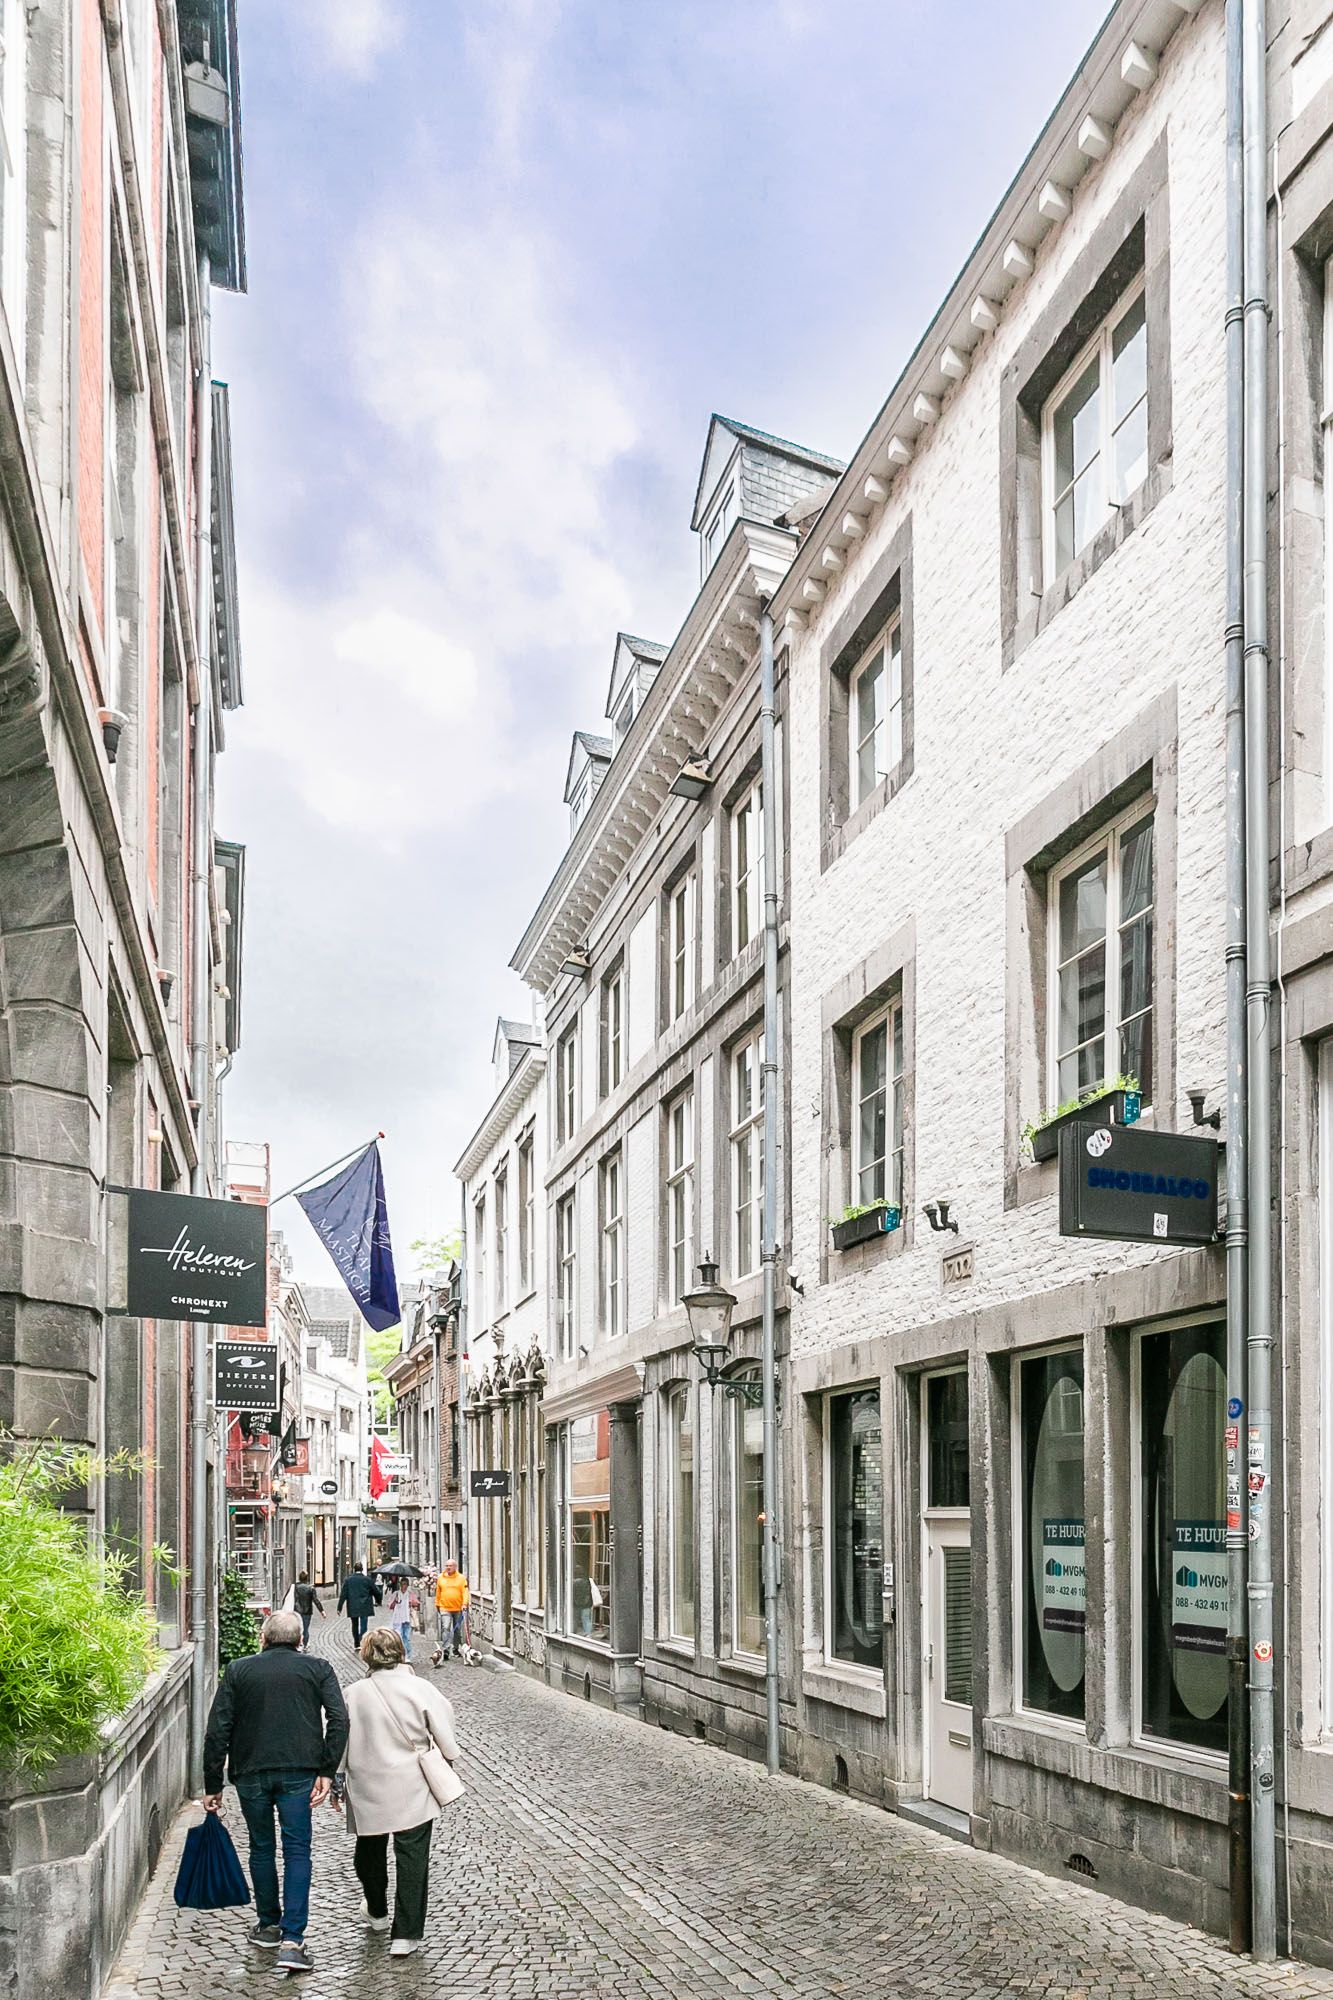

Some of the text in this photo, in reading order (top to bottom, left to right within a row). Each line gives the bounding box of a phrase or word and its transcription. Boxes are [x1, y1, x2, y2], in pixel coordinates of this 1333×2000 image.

[1088, 1167, 1209, 1199] SHOEBALOO
[140, 1225, 257, 1271] Heleven
[181, 1266, 242, 1277] BOUTIQUE
[171, 1296, 229, 1309] CHRONEXT
[189, 1306, 211, 1315] Lounge
[217, 1371, 275, 1381] SIEFERS
[1045, 1525, 1086, 1538] TE HUUR
[1176, 1527, 1193, 1542] TE
[1062, 1565, 1086, 1577] MVGM
[1045, 1584, 1055, 1594] 088
[1060, 1586, 1070, 1596] 432
[1175, 1597, 1189, 1607] 088
[1194, 1599, 1208, 1610] 432
[1209, 1600, 1219, 1611] 49
